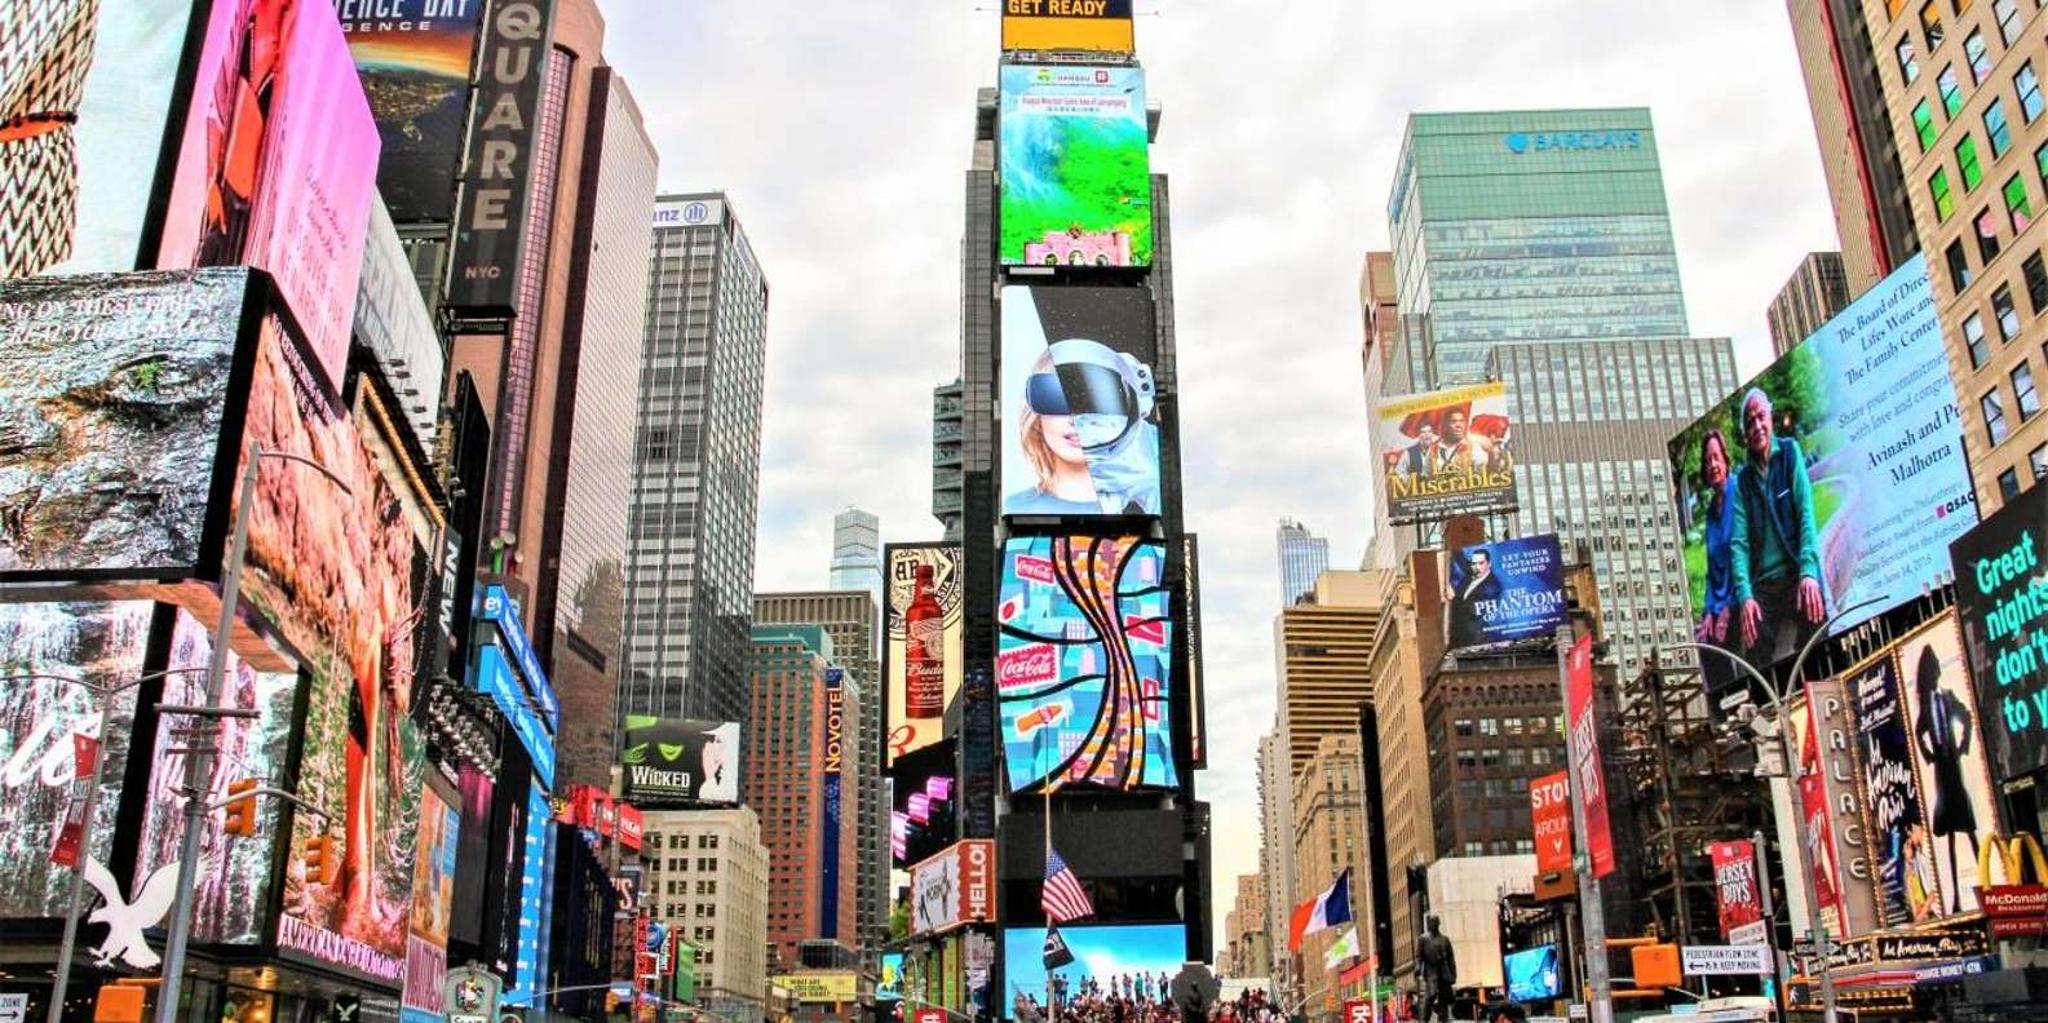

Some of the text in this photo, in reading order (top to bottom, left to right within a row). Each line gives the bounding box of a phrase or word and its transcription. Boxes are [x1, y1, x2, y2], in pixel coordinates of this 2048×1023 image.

[1008, 0, 1106, 16] GET READY
[1535, 133, 1639, 150] BARCLAYS
[465, 266, 501, 280] NYC
[1838, 325, 1856, 344] The
[1856, 298, 1887, 331] Board
[1844, 316, 1938, 385] The Family Center
[1867, 429, 1916, 471] Avinash
[1918, 410, 1942, 441] and
[1889, 443, 1952, 488] Malhotra
[1976, 530, 2037, 595] Great
[438, 540, 459, 637] NEW
[1474, 588, 1562, 615] PHANTOM
[826, 680, 843, 774] NOVOTEL
[2004, 695, 2030, 733] to
[1822, 696, 1870, 879] PALACE
[970, 843, 987, 918] HELLO!
[1716, 860, 1754, 886] JERSEY
[1723, 881, 1750, 903] BOYS
